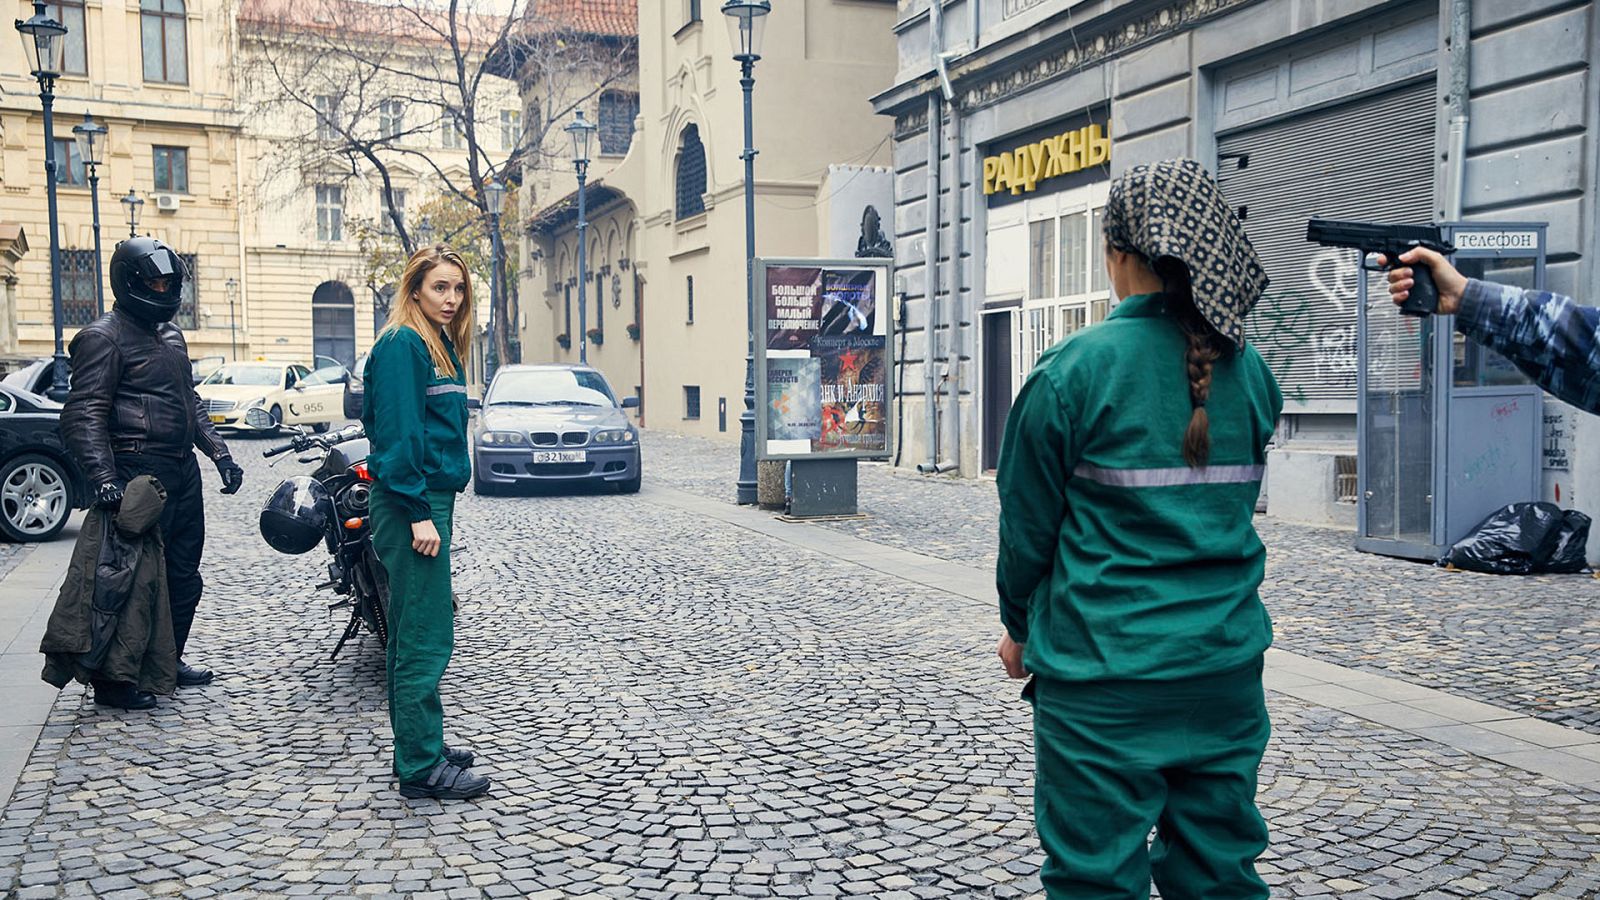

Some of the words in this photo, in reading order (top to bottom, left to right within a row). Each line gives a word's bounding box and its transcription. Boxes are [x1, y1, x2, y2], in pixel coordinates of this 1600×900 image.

[1459, 230, 1531, 250] телефон
[775, 295, 814, 307] БОЛЬШЕ
[776, 307, 812, 319] МАЛЫЙ
[303, 402, 324, 413] 955
